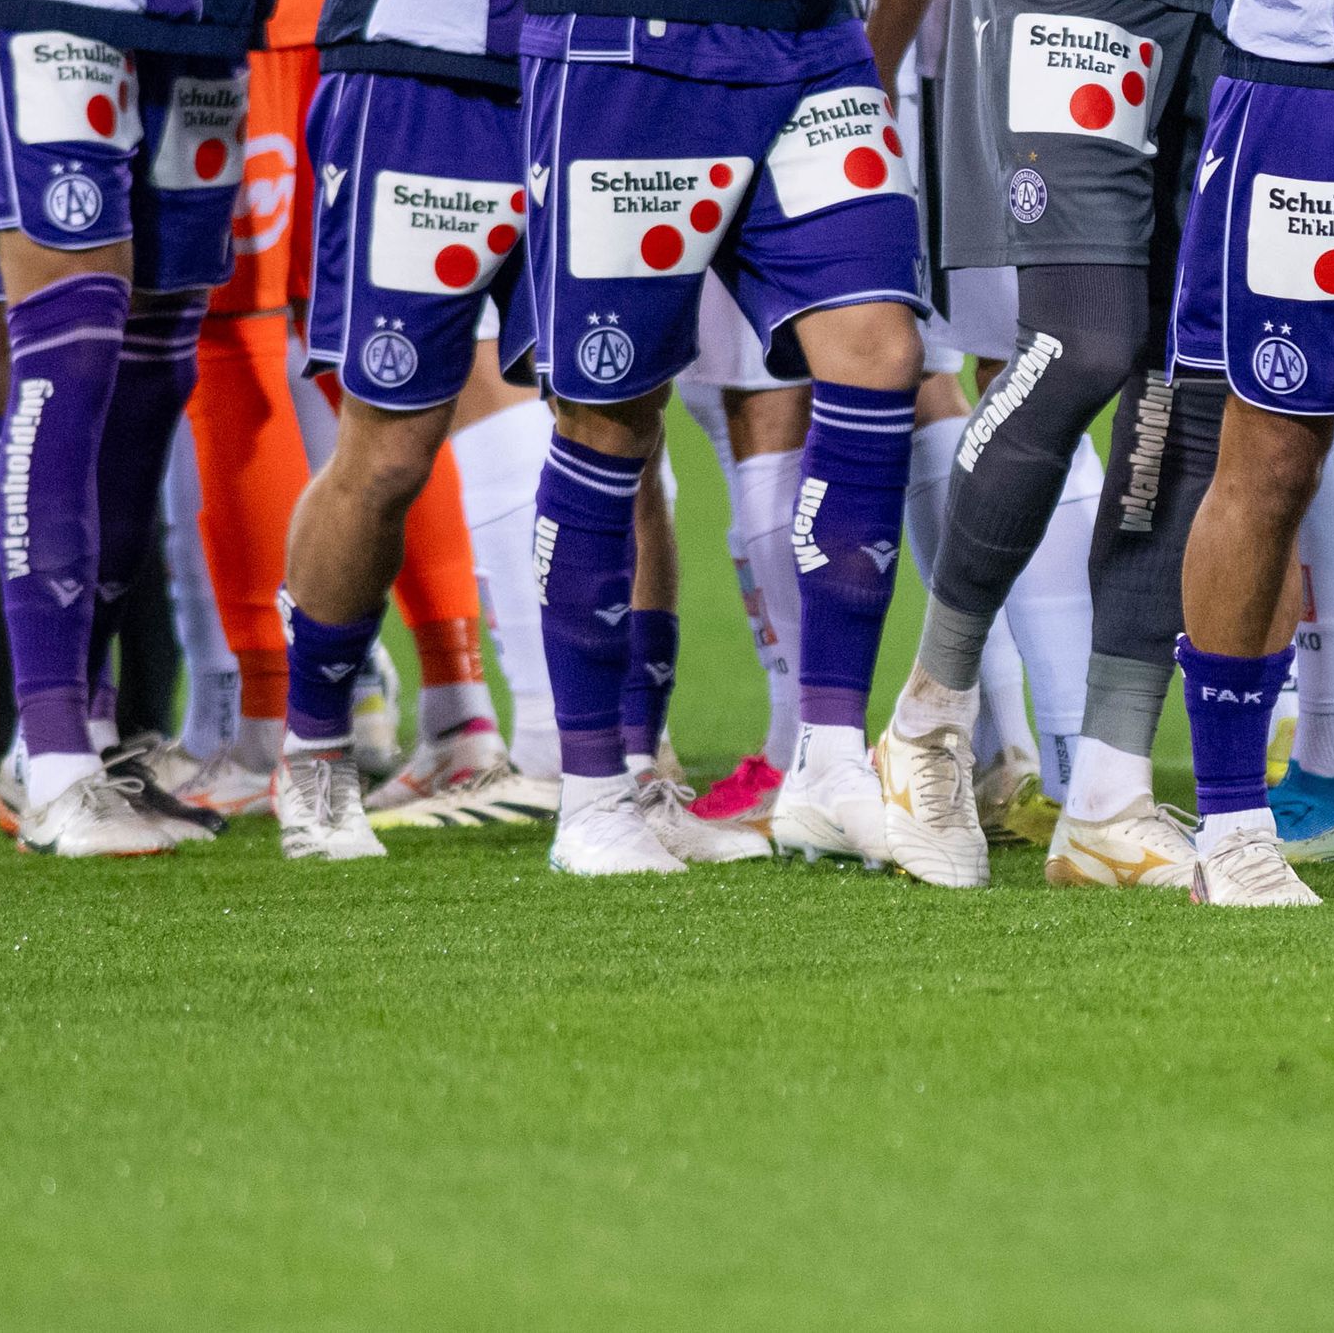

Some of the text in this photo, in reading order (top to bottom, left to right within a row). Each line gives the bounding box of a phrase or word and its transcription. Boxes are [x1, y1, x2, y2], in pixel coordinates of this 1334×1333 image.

[1030, 25, 1132, 59] Schuller
[779, 98, 881, 134] Schuller
[590, 171, 699, 193] Schuller
[394, 185, 499, 214] Schuller
[1202, 686, 1264, 705] FAK
